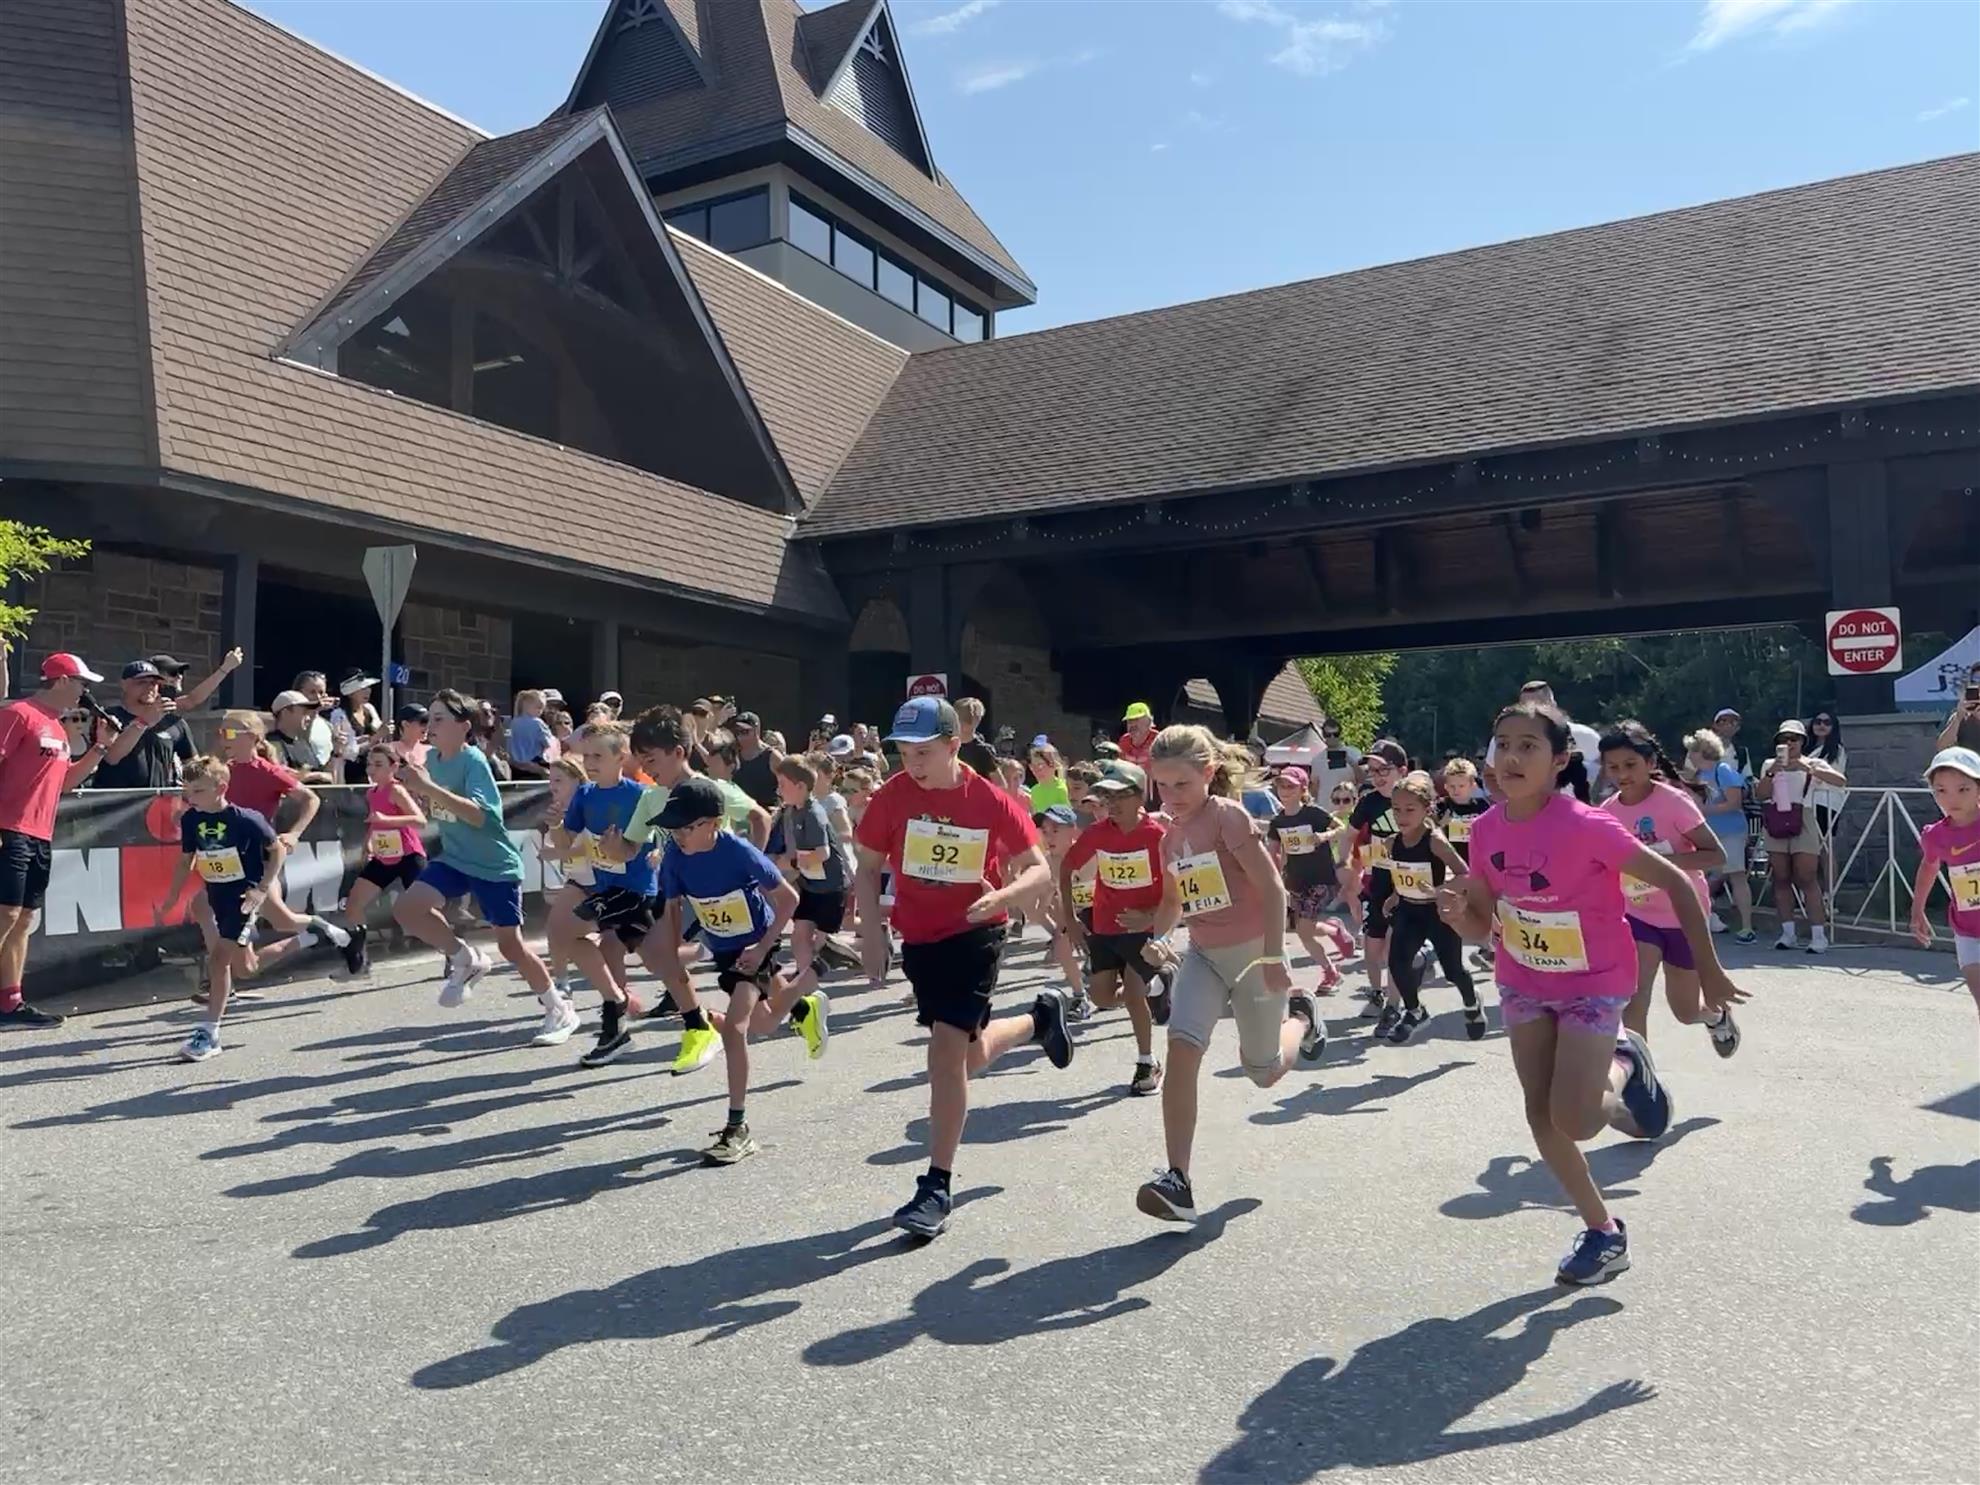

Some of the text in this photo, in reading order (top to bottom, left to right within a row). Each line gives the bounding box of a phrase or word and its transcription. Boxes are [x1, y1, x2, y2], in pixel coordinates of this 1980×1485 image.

[1839, 622, 1887, 635] DO NOT
[1844, 650, 1886, 662] ENTER
[932, 844, 959, 864] 92
[209, 862, 224, 873] 18
[1109, 866, 1137, 879] 122
[1398, 874, 1414, 887] 10
[1180, 878, 1200, 898] 14
[1520, 929, 1550, 952] 34
